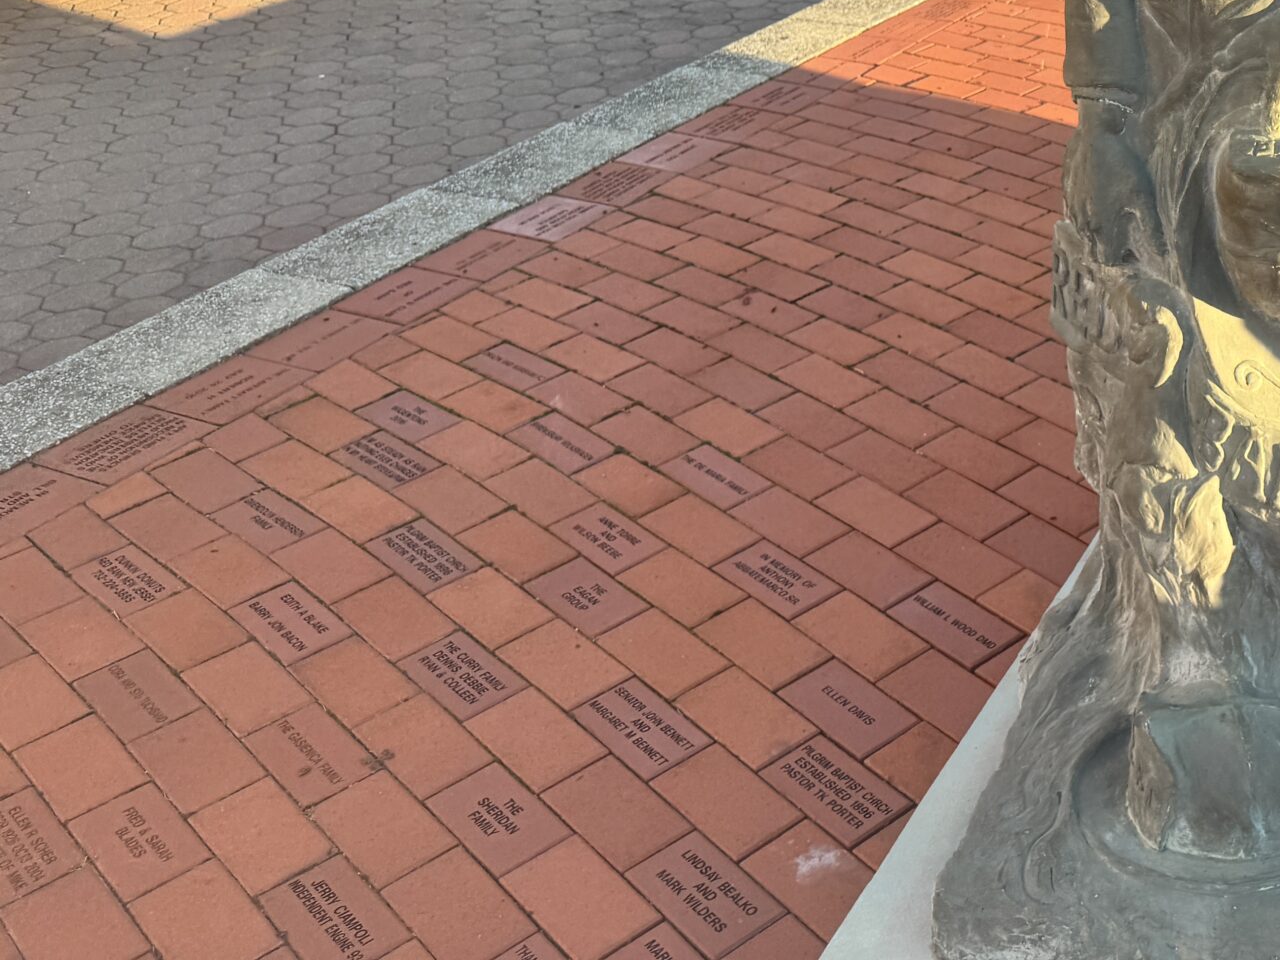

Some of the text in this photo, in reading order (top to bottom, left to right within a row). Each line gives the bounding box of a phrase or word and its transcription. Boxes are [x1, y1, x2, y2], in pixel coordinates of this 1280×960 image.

[680, 454, 696, 464] THE
[703, 469, 727, 481] MARIA
[724, 481, 749, 495] FAMILY
[250, 515, 273, 529] FAMILY
[271, 517, 306, 536] HENDERSON
[403, 525, 428, 541] PILGRIM
[423, 540, 449, 557] BAPTIST
[572, 525, 623, 558] WILSON BEEBE
[597, 517, 641, 544] ANNE TORRE
[599, 531, 616, 541] AND
[381, 537, 408, 555] PASTOR
[413, 562, 442, 582] PORTER
[394, 533, 438, 563] ESTABLISHED
[97, 557, 156, 602] RED BANK NEW JERSEY
[136, 573, 164, 592] DONUTS
[589, 584, 607, 595] THE
[758, 565, 794, 587] ANTHONY
[759, 553, 816, 589] IN MEMORY OF
[279, 594, 329, 633] EDITH A BLAKE
[560, 592, 589, 611] GROUP
[572, 586, 601, 604] EAGAN
[248, 602, 307, 651] BARRY JON BACON
[911, 596, 945, 616] WILLIAM
[949, 619, 978, 636] WOOD
[975, 635, 997, 648] DMD
[107, 665, 127, 679] CORA
[417, 656, 479, 704] RYAN & COLLEEN
[442, 641, 507, 691] THE CURRY FAMILY
[612, 687, 695, 750] SENATOR JOHN BENNETT
[630, 718, 651, 732] AND
[819, 686, 877, 725] ELLEN DAVIS
[275, 720, 294, 733] THE
[316, 763, 344, 785] FAMILY
[587, 701, 669, 766] MARGARET M BENNETT
[778, 764, 865, 828] PASTOR TK PORTER
[792, 757, 876, 819] ESTABLISHED 1896
[799, 745, 894, 815] PILGRIM BAPTIST CHRCH
[466, 810, 500, 837] FAMILY
[476, 797, 520, 834] SHERIDAN
[501, 799, 524, 815] THE
[6, 806, 58, 864] ELLEN R SCHER
[113, 826, 147, 858] BLADES
[121, 806, 174, 862] FRED & SARAH
[654, 869, 729, 933] MARK WILDERS
[679, 849, 760, 916] LINDSAY BEALKO
[692, 881, 718, 901] AND
[285, 880, 332, 926] INDEPENDENT
[324, 923, 355, 953] ENGINE
[309, 877, 375, 946] JERRY CIAMPOLI
